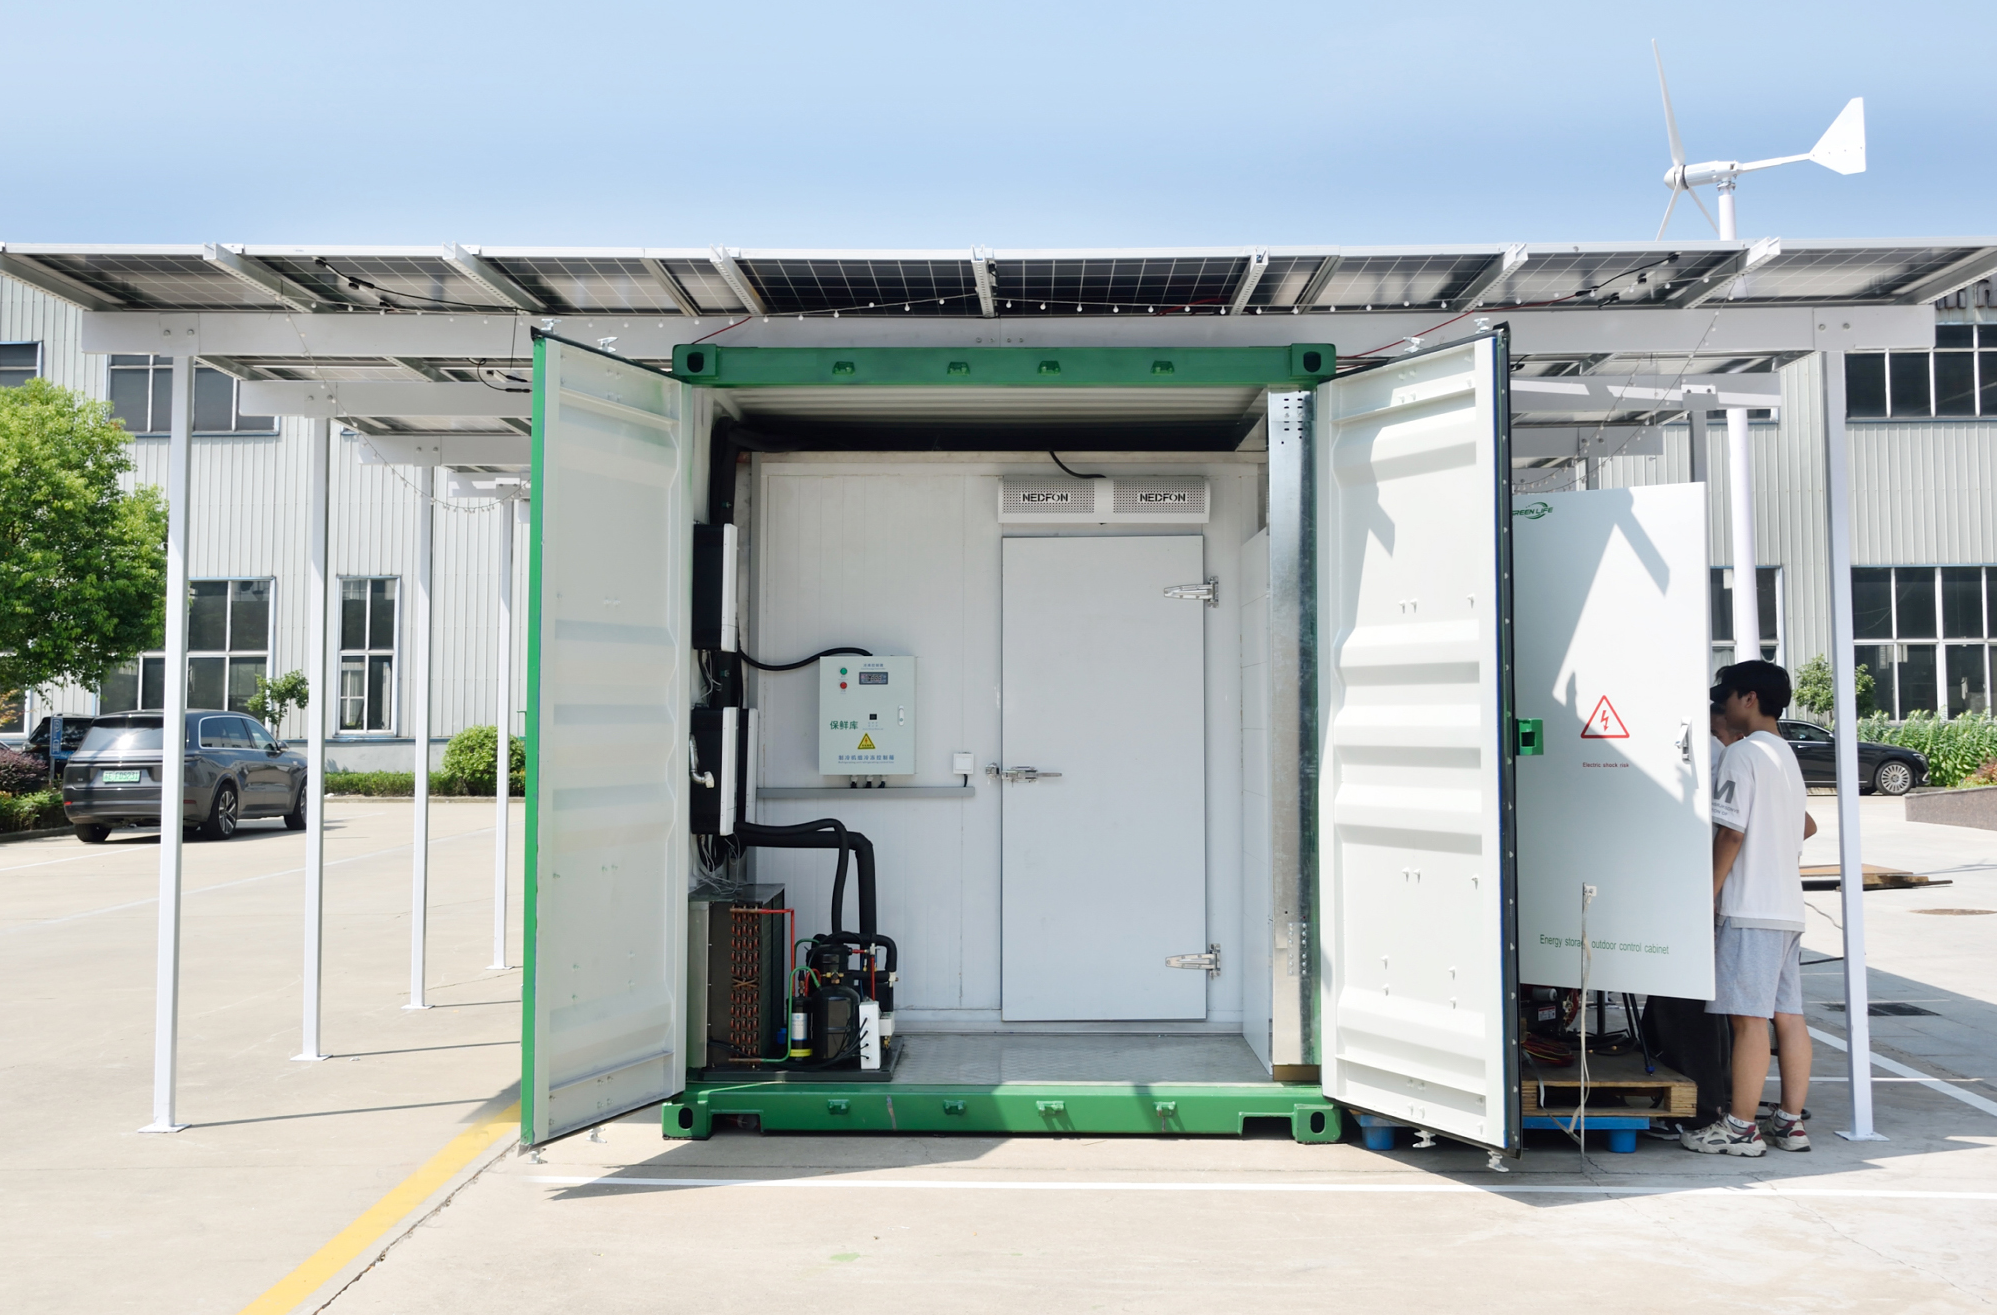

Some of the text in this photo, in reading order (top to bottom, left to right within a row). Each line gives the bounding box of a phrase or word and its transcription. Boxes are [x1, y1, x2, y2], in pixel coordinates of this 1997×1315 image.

[1022, 493, 1069, 502] NEDFON
[1139, 493, 1186, 502] NEDFON
[830, 720, 858, 730] 保鲜库
[1540, 934, 1669, 955] Energy storag outdoor control cabinet
